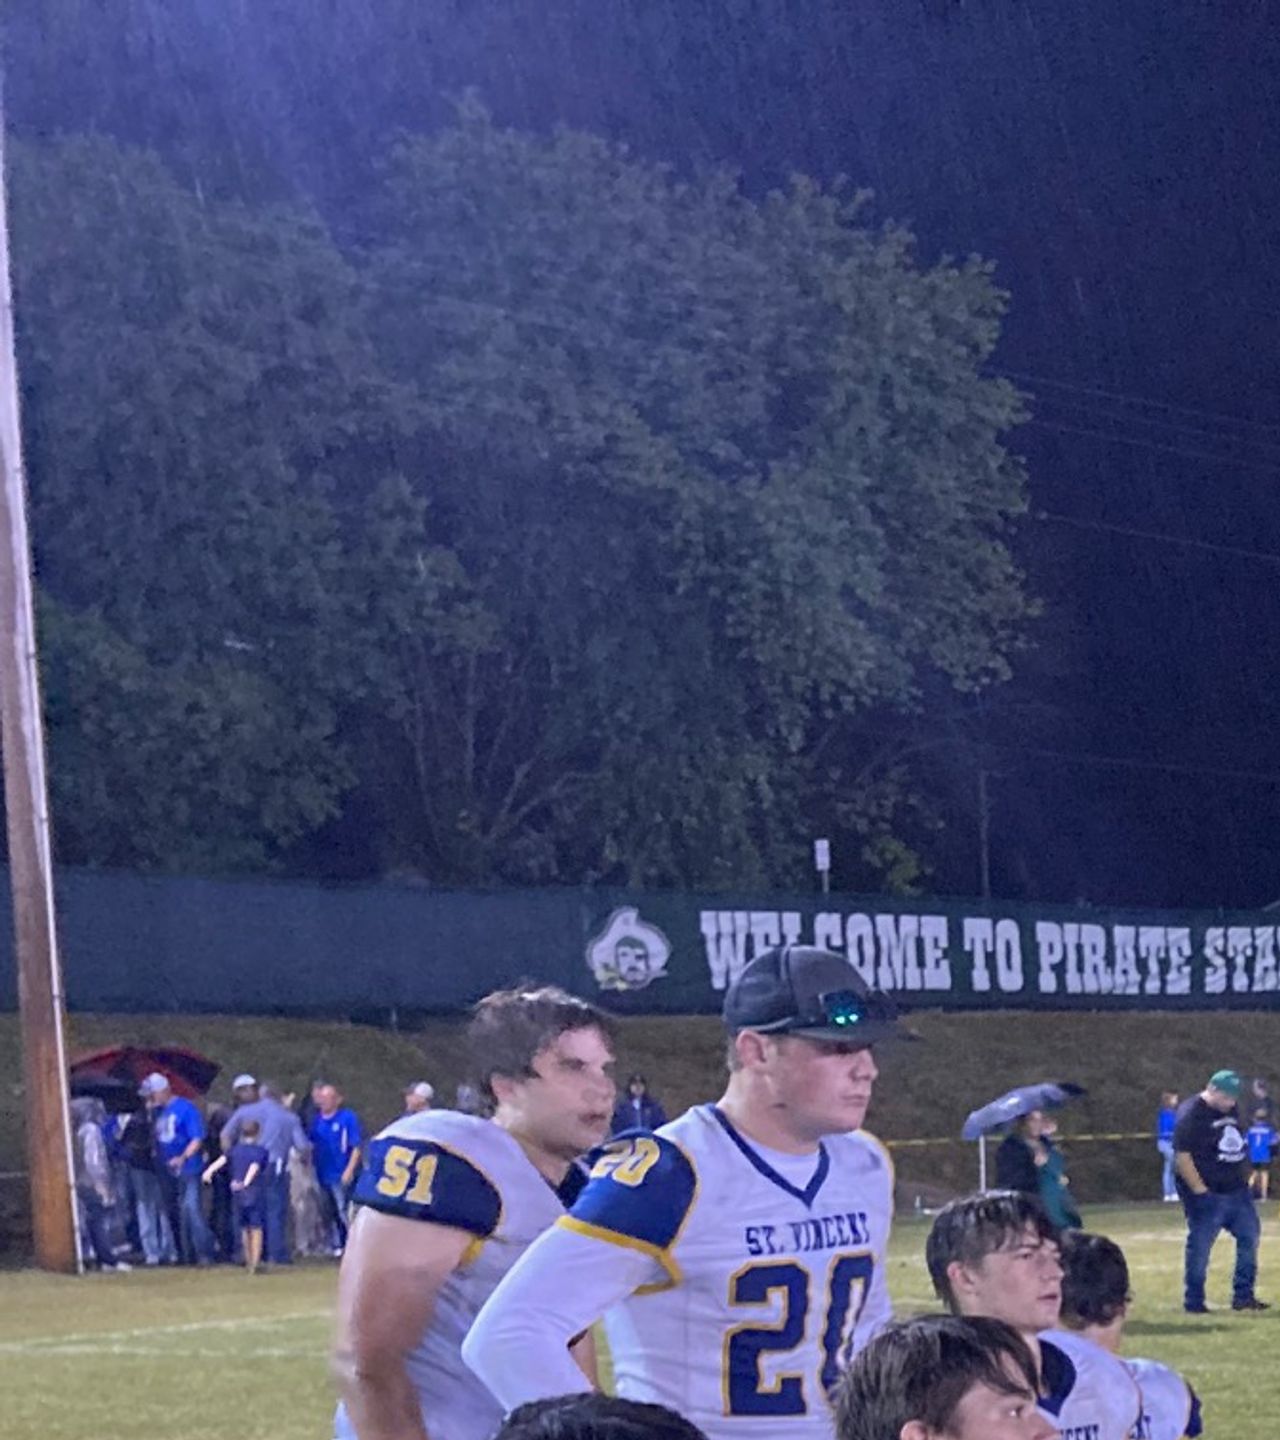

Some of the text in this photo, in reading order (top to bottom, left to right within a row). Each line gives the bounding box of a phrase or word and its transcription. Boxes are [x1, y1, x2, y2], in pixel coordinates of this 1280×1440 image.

[963, 917, 1024, 992] TO
[1035, 920, 1192, 995] PIRATE
[376, 1145, 438, 1205] 51
[590, 1138, 661, 1188] 20
[745, 1212, 871, 1256] ST. VINCENT
[722, 1249, 877, 1417] 20
